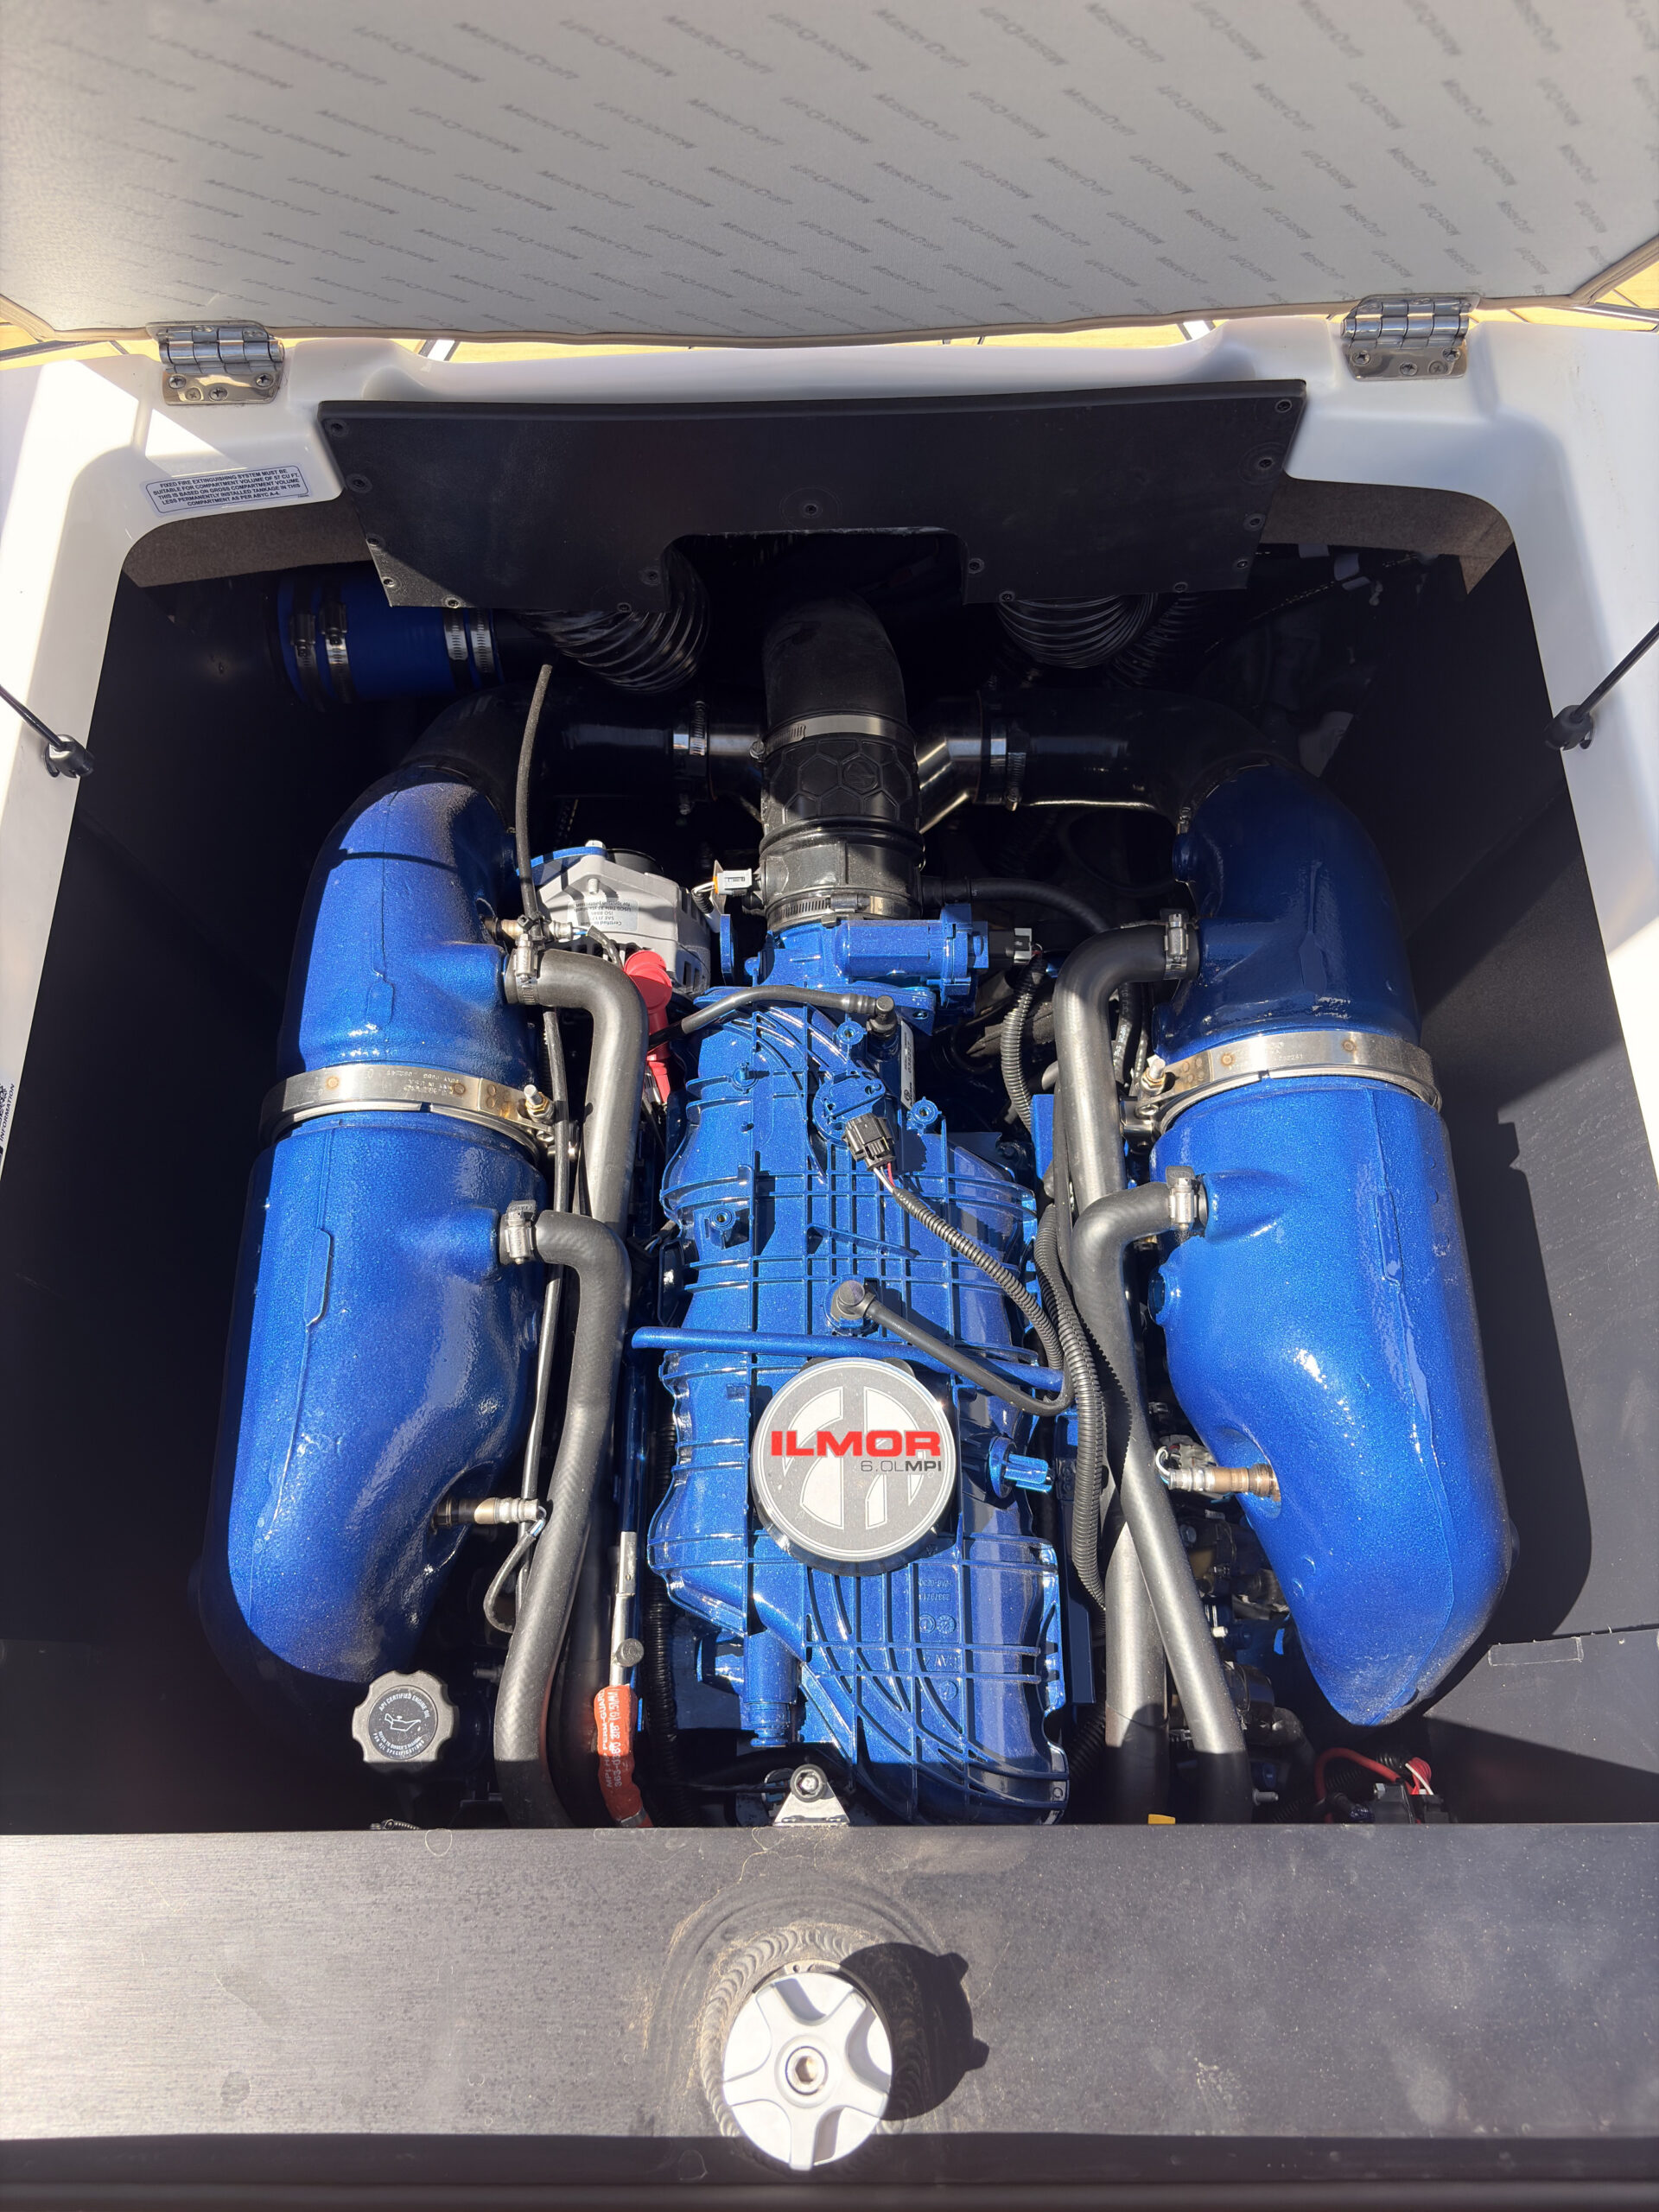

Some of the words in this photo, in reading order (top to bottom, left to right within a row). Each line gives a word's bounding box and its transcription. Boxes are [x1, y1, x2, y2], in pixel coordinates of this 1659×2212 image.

[193, 475, 237, 485] EXTINGUISHING
[195, 480, 238, 490] COMPARTMENT
[231, 482, 274, 490] COMPARTMENT
[178, 493, 219, 502] PERMANENTLY
[188, 496, 230, 506] COMPARTMENT
[0, 1084, 14, 1141] INFORMATION
[771, 1430, 941, 1457] ILMOR
[379, 1702, 387, 1711] API
[386, 1693, 412, 1704] CERTIFIED
[412, 1695, 427, 1710] ENGINE
[387, 1740, 425, 1755] SPECIFICATIONS
